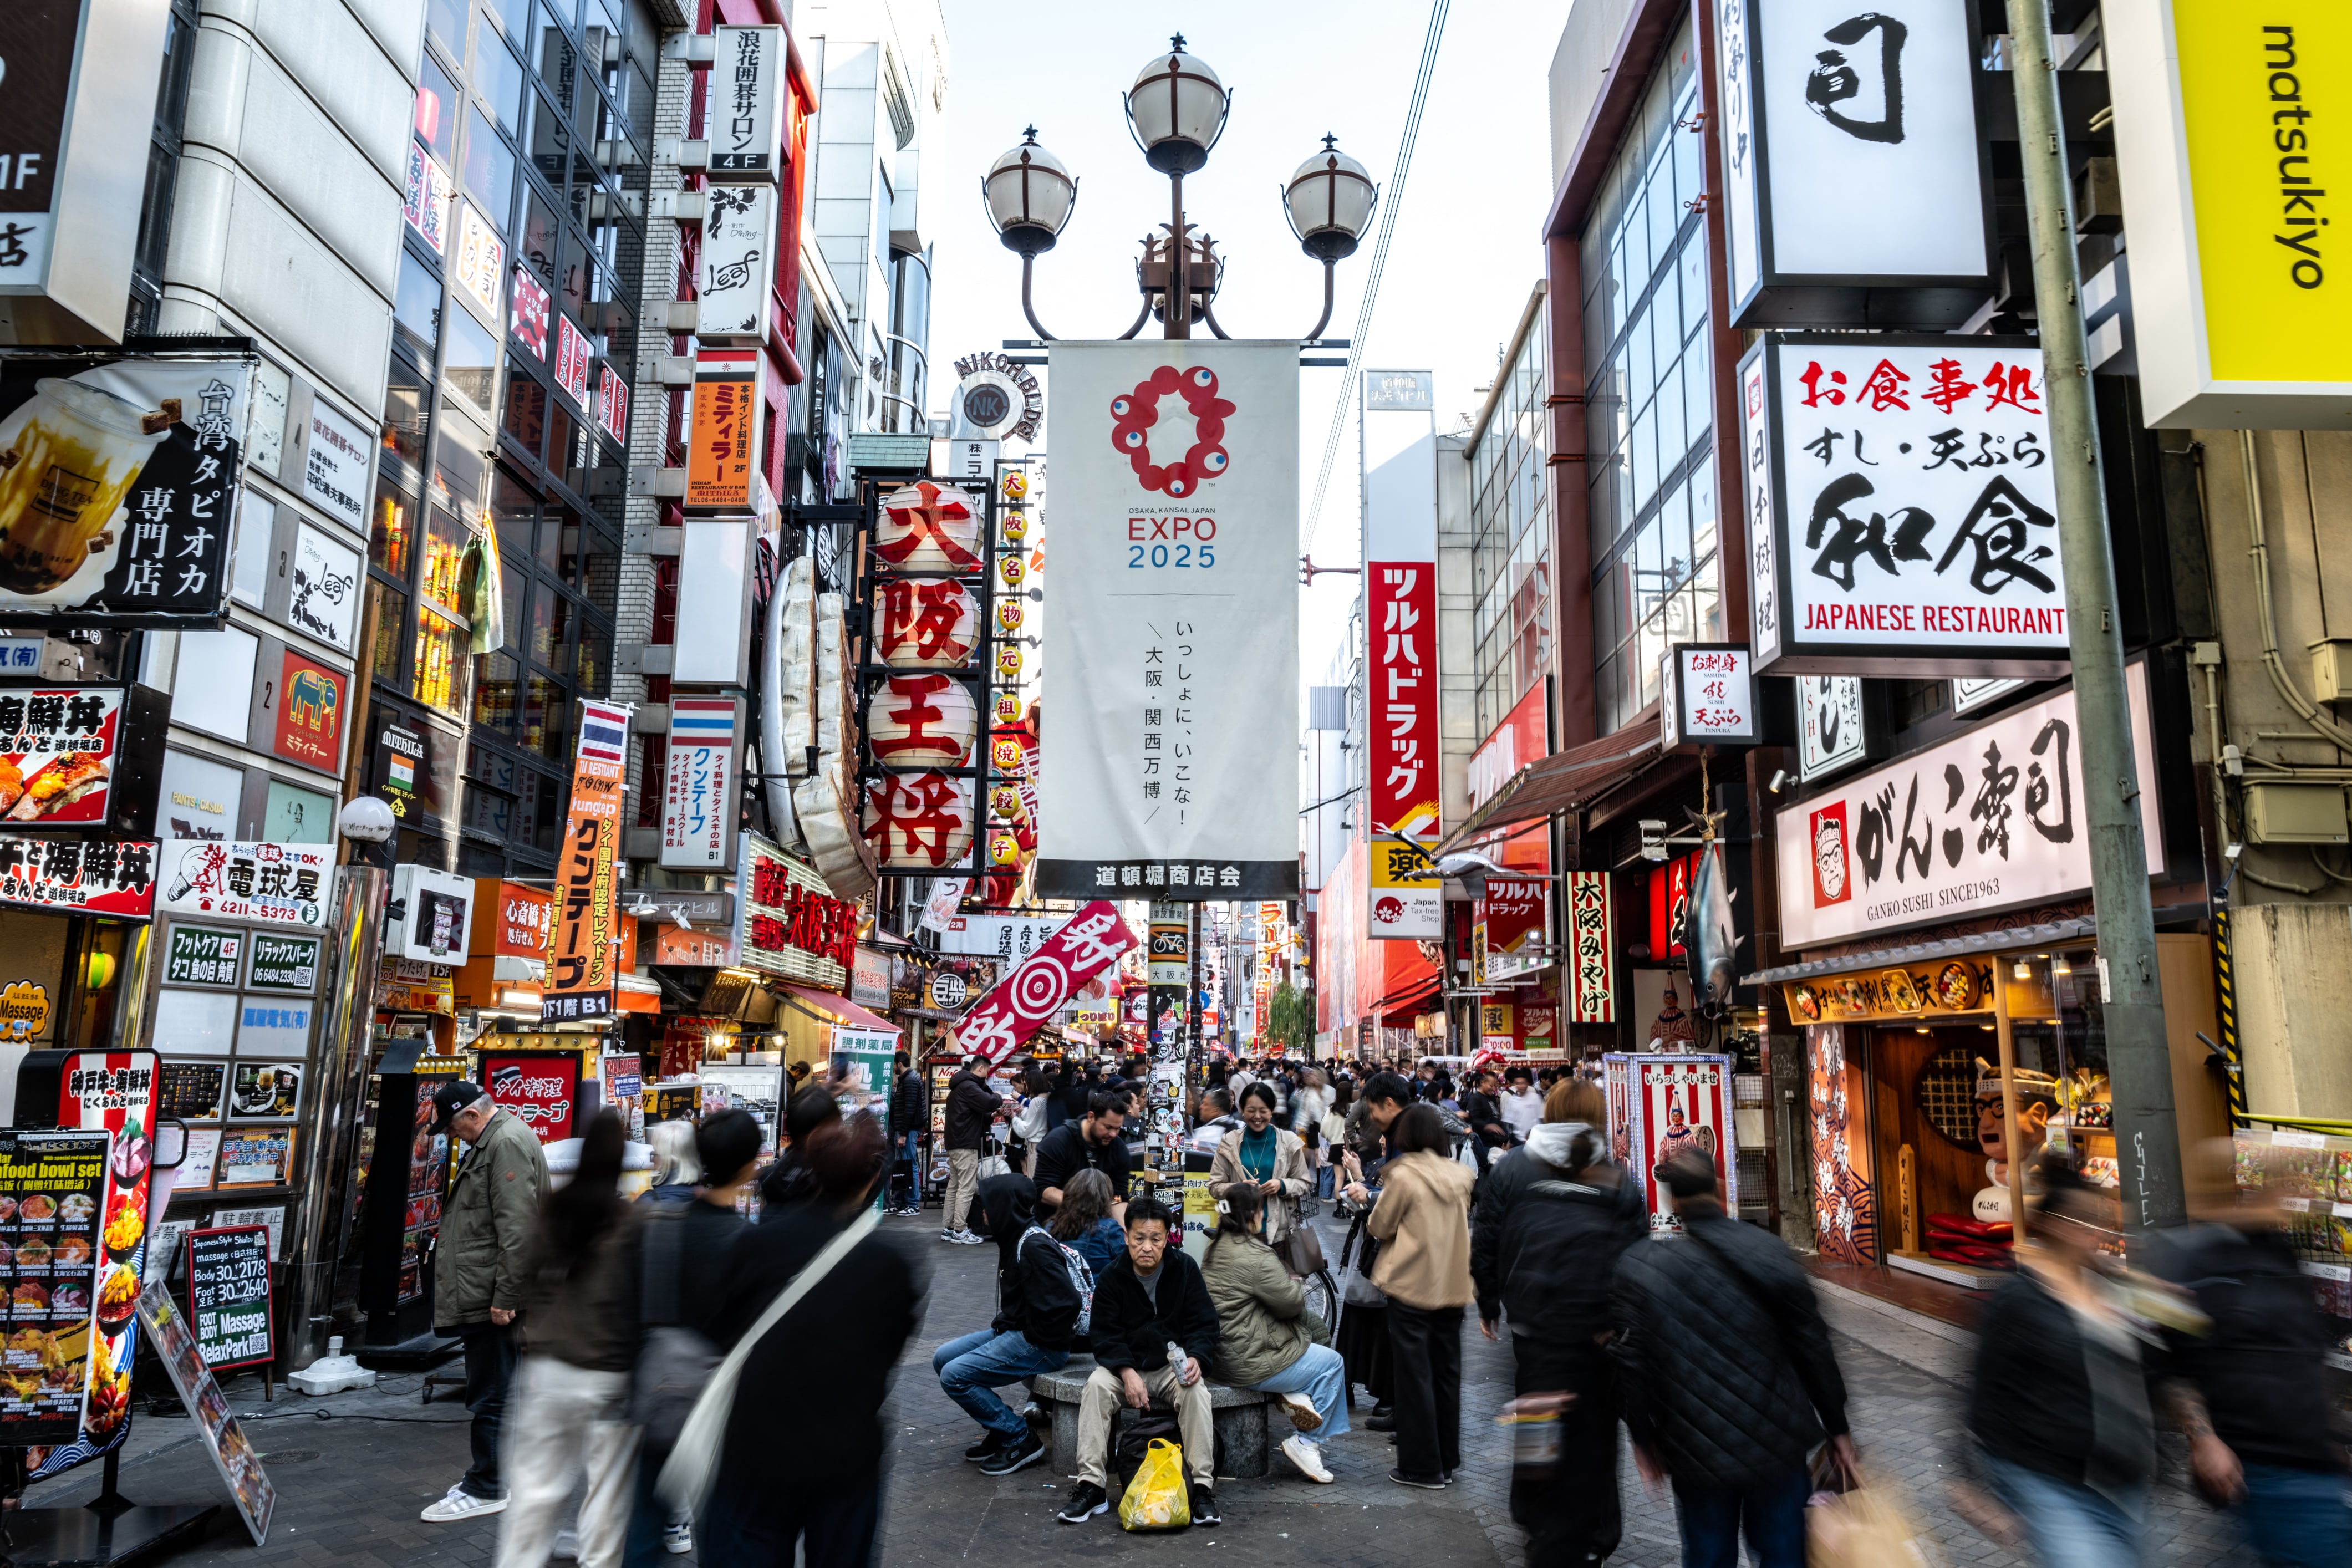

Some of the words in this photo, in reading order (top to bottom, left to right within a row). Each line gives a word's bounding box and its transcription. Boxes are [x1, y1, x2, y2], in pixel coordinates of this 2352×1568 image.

[731, 30, 761, 152] 浪花囲碁サロン
[2262, 24, 2330, 290] matsukiyo
[482, 243, 497, 306] 寿司
[702, 250, 759, 296] Leaf
[559, 323, 571, 384] 大阪名物
[573, 339, 585, 400] もつ鍋
[601, 368, 612, 426] 日本酒
[1799, 357, 2043, 415] お食事処
[698, 385, 708, 426] 印度美食宴
[711, 385, 735, 482] ミティラー
[736, 384, 750, 459] 本格インド料理店
[313, 418, 368, 466] 浪花囲碁サロン
[1803, 426, 2046, 471] すし・天ぷら
[734, 464, 746, 473] 2F
[173, 380, 234, 597] 台湾タピオカ
[307, 471, 362, 517] 平松満夫事務所
[1128, 517, 1216, 541] EXPO
[1805, 472, 2056, 595] 和食
[123, 487, 176, 597] 専門店
[1128, 544, 1215, 568] 2025
[314, 562, 353, 606] Leaf
[1804, 603, 1916, 632] JAPANESE
[1923, 605, 2065, 635] RESTAURANT
[864, 480, 987, 868] 大阪王将
[992, 474, 1025, 858] 大阪名物元祖焼餃子
[1691, 653, 1738, 673] お刺身
[263, 681, 273, 710] 2
[1383, 569, 1424, 801] ツルハドラッグ
[1693, 707, 1742, 727] 天ぷら
[55, 739, 103, 751] 道頓堀店
[286, 734, 328, 758] ミティラー
[668, 754, 679, 805] タイ調味料
[690, 748, 710, 834] クンテープ
[381, 784, 401, 796] インド料理店
[401, 791, 416, 800] ミティラー
[676, 754, 690, 847] タイカルチャースクール
[709, 754, 724, 848] タイ料理とタイスキの店
[393, 802, 403, 814] 2F
[665, 816, 676, 847] 食材店
[232, 844, 256, 856] あらゆる
[709, 851, 719, 860] B1
[1096, 866, 1241, 887] 道頓堀商店会
[1388, 848, 1423, 883] 薬
[227, 858, 320, 903] 電球屋
[1488, 882, 1544, 901] ツルハ
[48, 887, 86, 904] 道頓堀店
[556, 819, 599, 989] クンテープ
[589, 818, 613, 986] タイ国政府認定レストラン
[1413, 898, 1439, 907] Japan.
[1866, 900, 1901, 922] GANKO
[1902, 892, 1934, 915] SUSHI
[1938, 877, 2001, 907] SINCE1963
[506, 898, 539, 928] 心斎橋
[1421, 915, 1440, 923] Shop
[1489, 903, 1534, 915] ドラッグ
[507, 927, 535, 947] 処方せん
[950, 921, 963, 929] 2階
[176, 933, 220, 957] フットケア
[223, 942, 235, 956] 4F
[257, 941, 314, 965] リラックスパーク
[1574, 879, 1609, 1015] 大阪みやげ
[171, 957, 189, 979] タコ
[190, 958, 217, 982] 魚の目
[217, 961, 235, 984] 角質
[254, 967, 263, 981] 06
[263, 968, 279, 983] 6484
[279, 970, 295, 984] 2330
[1152, 970, 1186, 980] 大阪市
[0, 999, 43, 1021] Massage
[582, 997, 607, 1014] B1
[1079, 1012, 1115, 1022] つりぼり
[1523, 1007, 1551, 1016] ツルハ
[1484, 1007, 1503, 1032] 薬
[842, 1036, 893, 1051] 調剤薬局
[605, 1059, 620, 1077] THAI
[620, 1057, 640, 1076] BUFFET
[1646, 1072, 1718, 1085] いらっしゃいませ
[70, 1068, 151, 1096] 神戸牛と海鮮丼
[496, 1077, 564, 1098] タイ料理
[83, 1096, 126, 1109] にくあんど
[223, 1139, 286, 1152] 忘年会・新年会
[228, 1152, 278, 1163] ご予約受付中
[38, 1163, 74, 1178] bowl
[78, 1162, 101, 1177] set
[1900, 1158, 1911, 1234] がんこ親父
[193, 1238, 219, 1249] Japanese
[218, 1235, 232, 1246] Style
[196, 1253, 228, 1264] massage
[194, 1270, 215, 1282] Body
[216, 1265, 232, 1281] 30
[195, 1286, 216, 1299] Foot
[218, 1284, 235, 1302] 30
[199, 1312, 217, 1326] FOOT
[220, 1311, 266, 1334] Massage
[200, 1326, 217, 1340] BODY
[199, 1335, 250, 1364] RelaxPark
